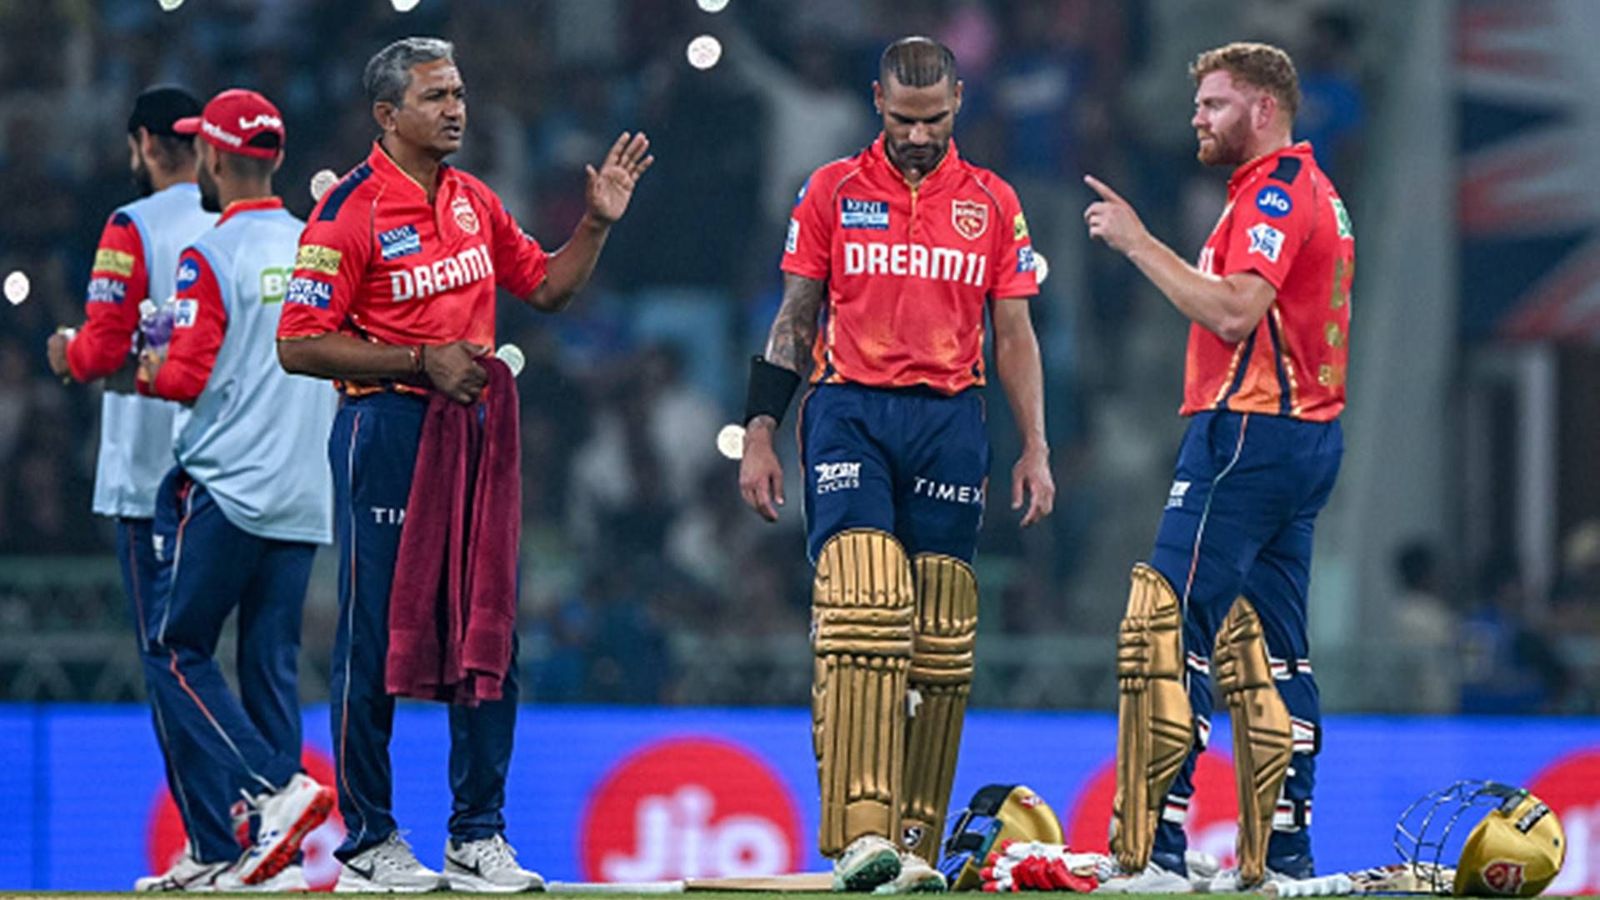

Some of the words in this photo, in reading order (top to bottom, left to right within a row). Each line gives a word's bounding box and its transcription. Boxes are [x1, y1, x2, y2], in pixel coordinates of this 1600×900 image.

[1258, 190, 1290, 212] Jio
[843, 241, 987, 287] DREAM11
[913, 475, 984, 504] TIMEX
[600, 783, 793, 884] Jio
